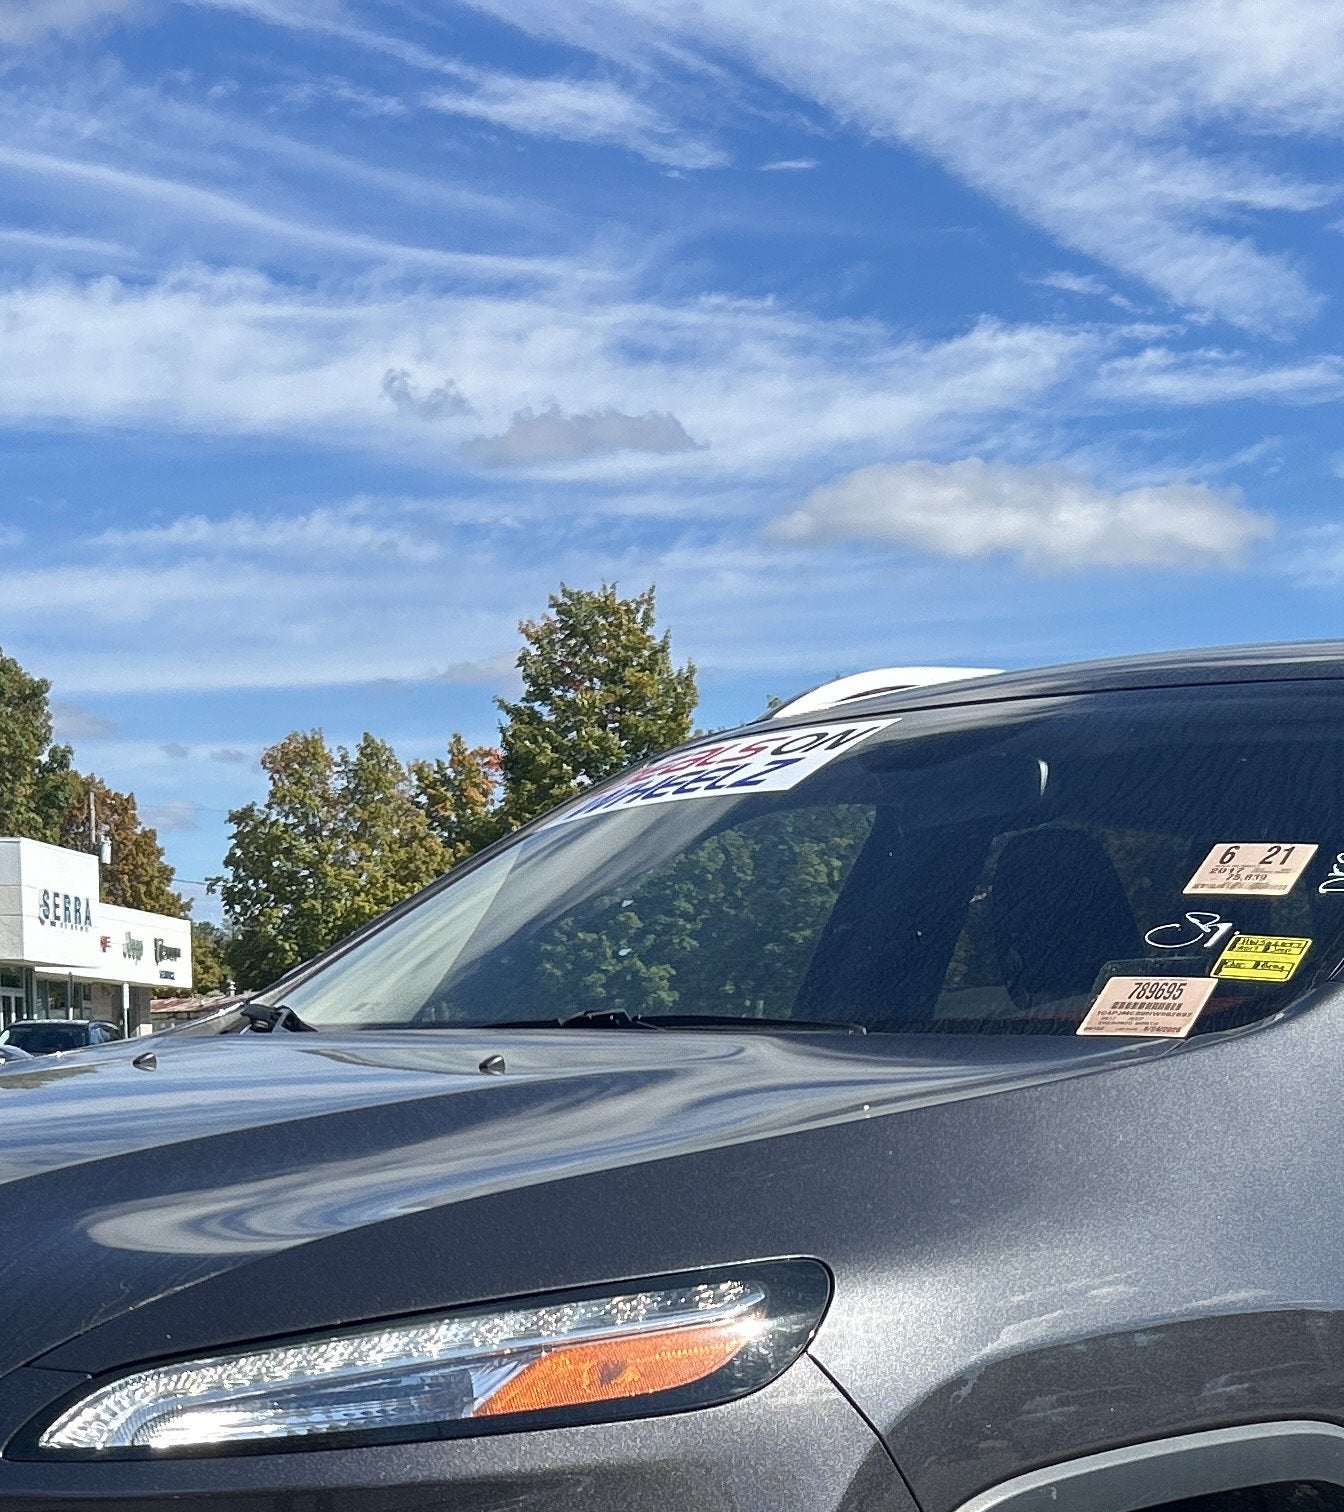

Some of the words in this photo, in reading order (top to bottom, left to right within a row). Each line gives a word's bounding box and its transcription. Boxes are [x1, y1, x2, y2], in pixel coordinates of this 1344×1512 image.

[770, 726, 882, 756] ON
[564, 757, 806, 820] WHEELZ
[1218, 845, 1241, 865] 6
[1259, 845, 1296, 866] 21
[40, 888, 93, 927] SERRA
[1127, 981, 1188, 1001] 789695
